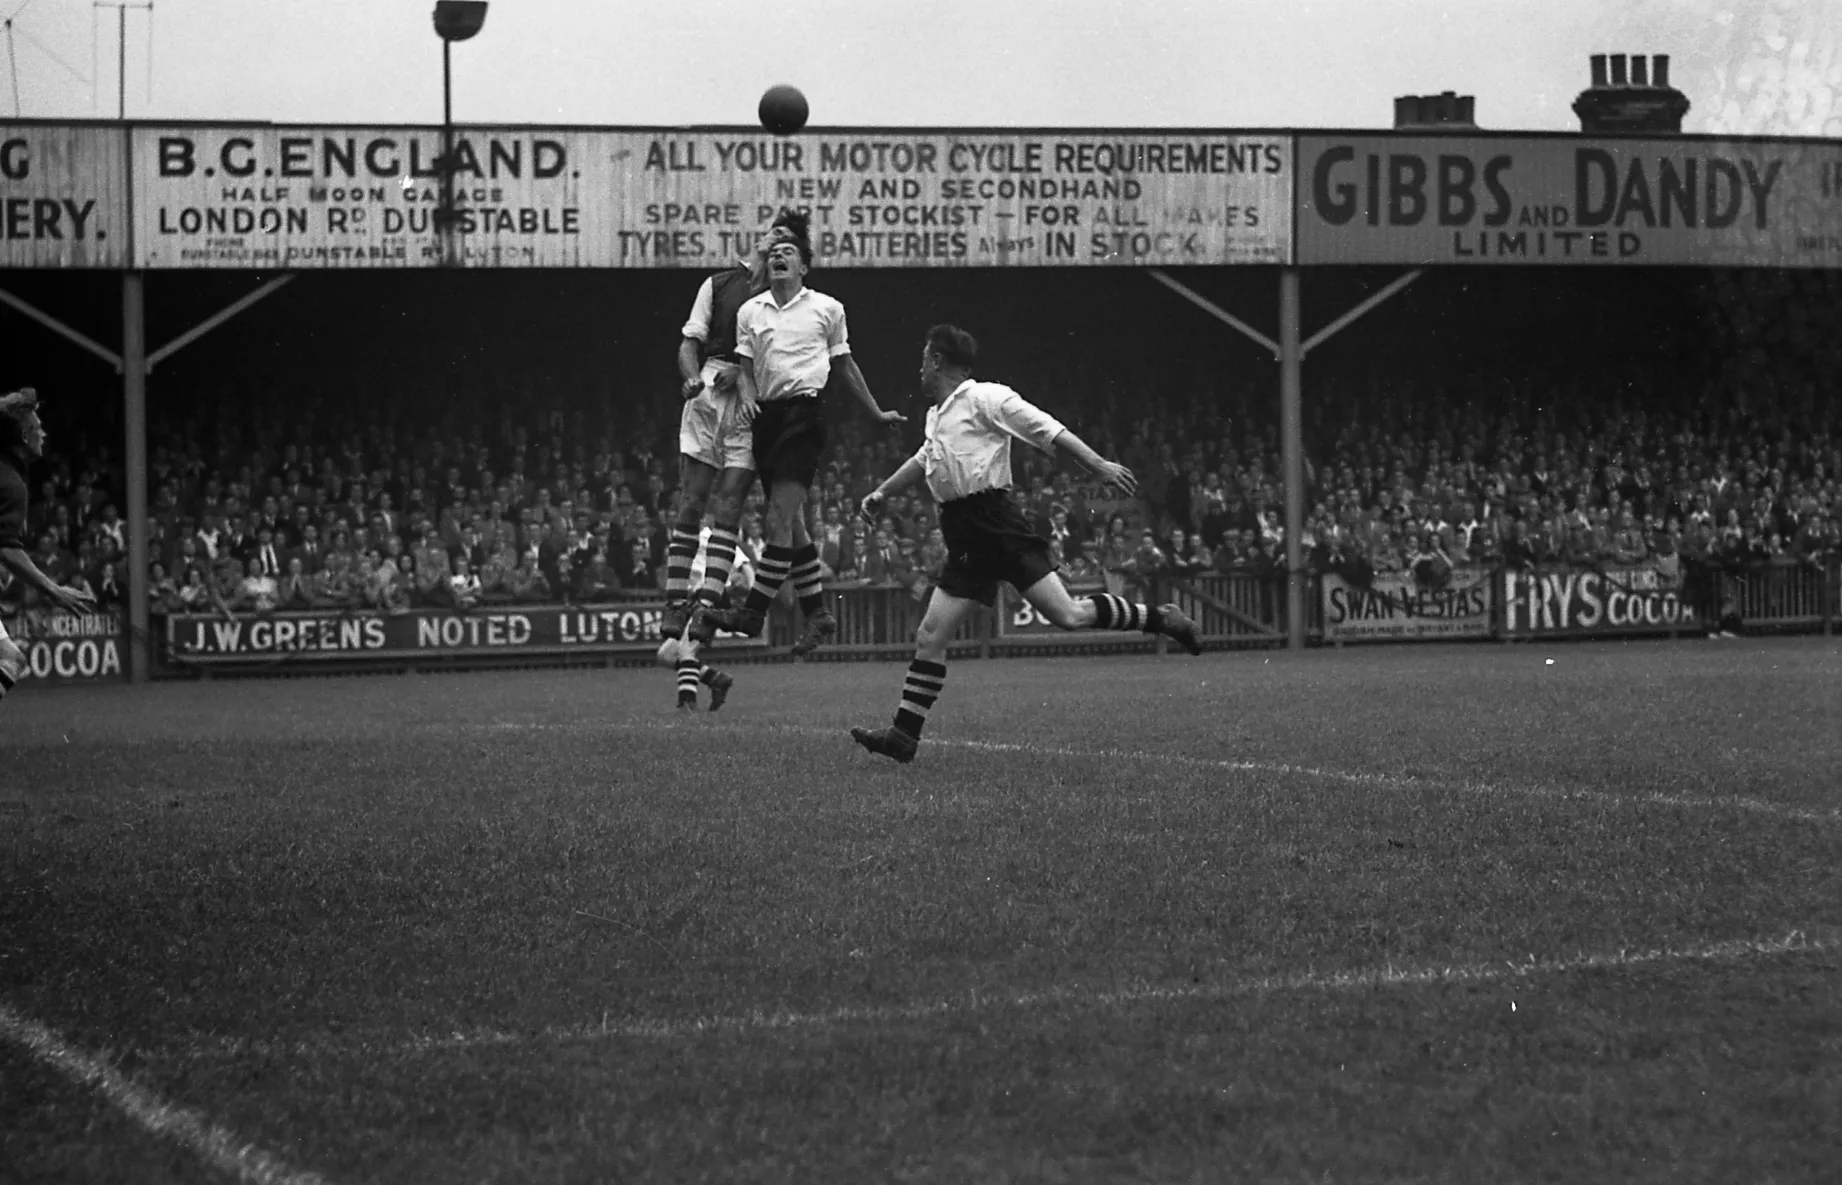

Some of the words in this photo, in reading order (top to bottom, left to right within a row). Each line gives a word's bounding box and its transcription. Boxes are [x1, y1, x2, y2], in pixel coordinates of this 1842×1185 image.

[1, 138, 30, 181] G
[645, 140, 705, 172] ALL
[715, 141, 803, 173] YOUR
[820, 143, 938, 173] MOTOR
[948, 142, 1042, 174] CYCLE
[1054, 143, 1283, 176] REQUIREMENTS
[222, 187, 289, 202] HALF
[309, 187, 385, 203] MOON
[402, 187, 503, 202] GAAGE
[776, 178, 842, 200] NEW
[858, 179, 921, 200] AND
[941, 179, 1142, 201] SECONDHAND
[1312, 144, 1512, 227] GIBBS
[1518, 204, 1569, 227] AND
[1575, 147, 1784, 231] DANDY
[0, 198, 106, 241] ERY.
[159, 207, 307, 235] LONDON
[646, 203, 741, 226] SPARE
[848, 204, 984, 226] STOCKIST
[1025, 206, 1080, 226] FOR
[1095, 206, 1148, 227] ALL
[820, 232, 968, 258] BATTERIES
[1046, 232, 1076, 258] IN
[1453, 231, 1642, 258] LIMITED
[1331, 587, 1393, 624] SWAN
[1400, 586, 1484, 619] VESTAS
[417, 614, 532, 648] NOTED
[559, 609, 663, 643] LUTON
